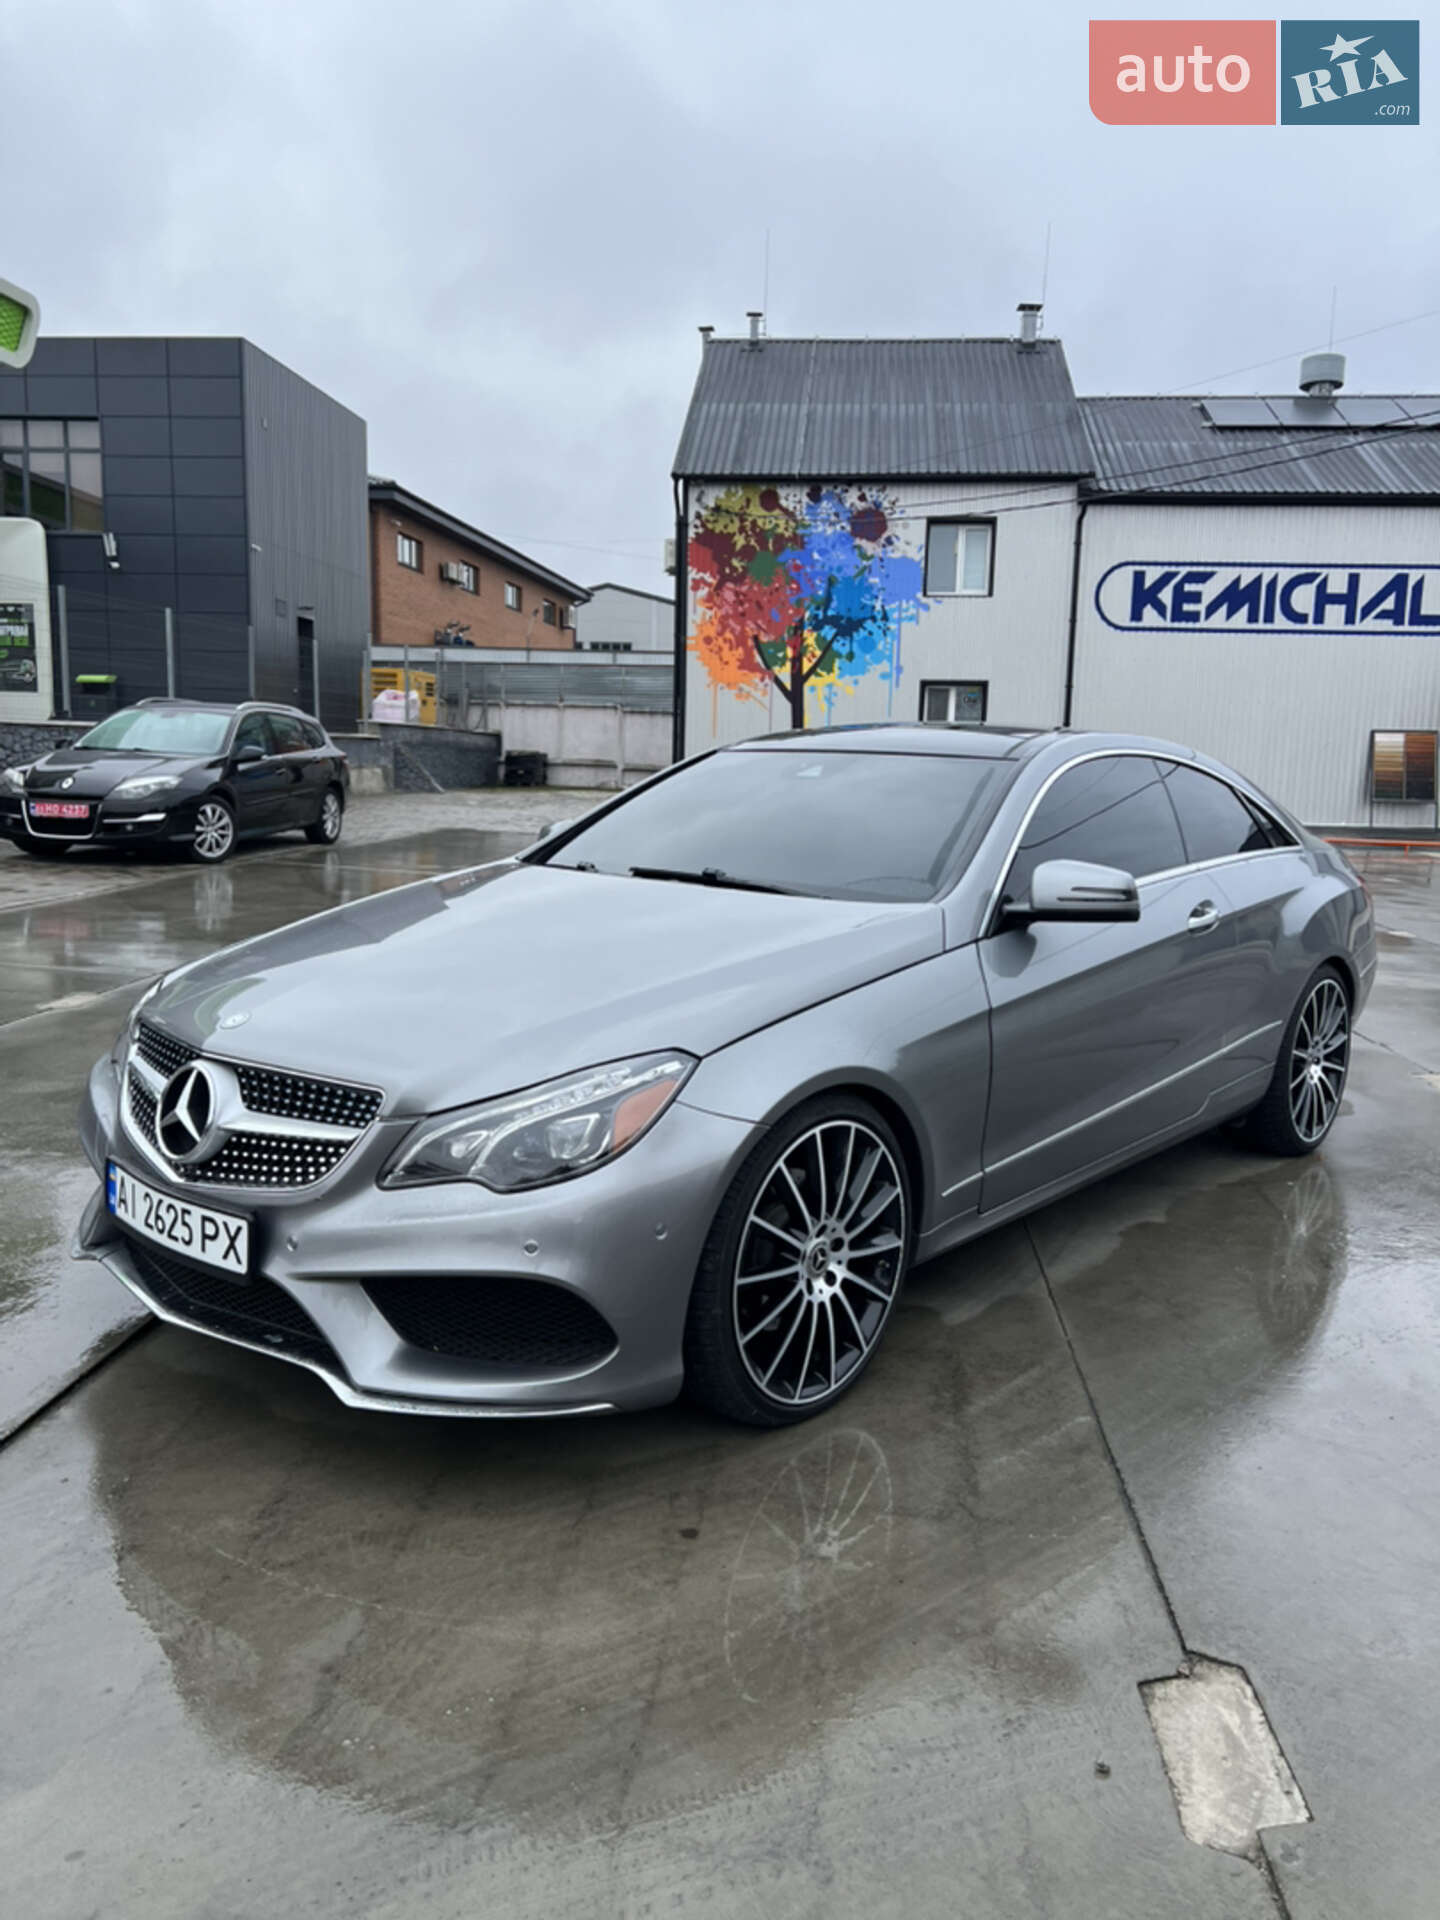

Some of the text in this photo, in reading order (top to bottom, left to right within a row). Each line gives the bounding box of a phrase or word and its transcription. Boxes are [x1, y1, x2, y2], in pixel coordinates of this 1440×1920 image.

[1129, 569, 1440, 626] KEMICHAL
[118, 1175, 242, 1265] AI 2625 PX
